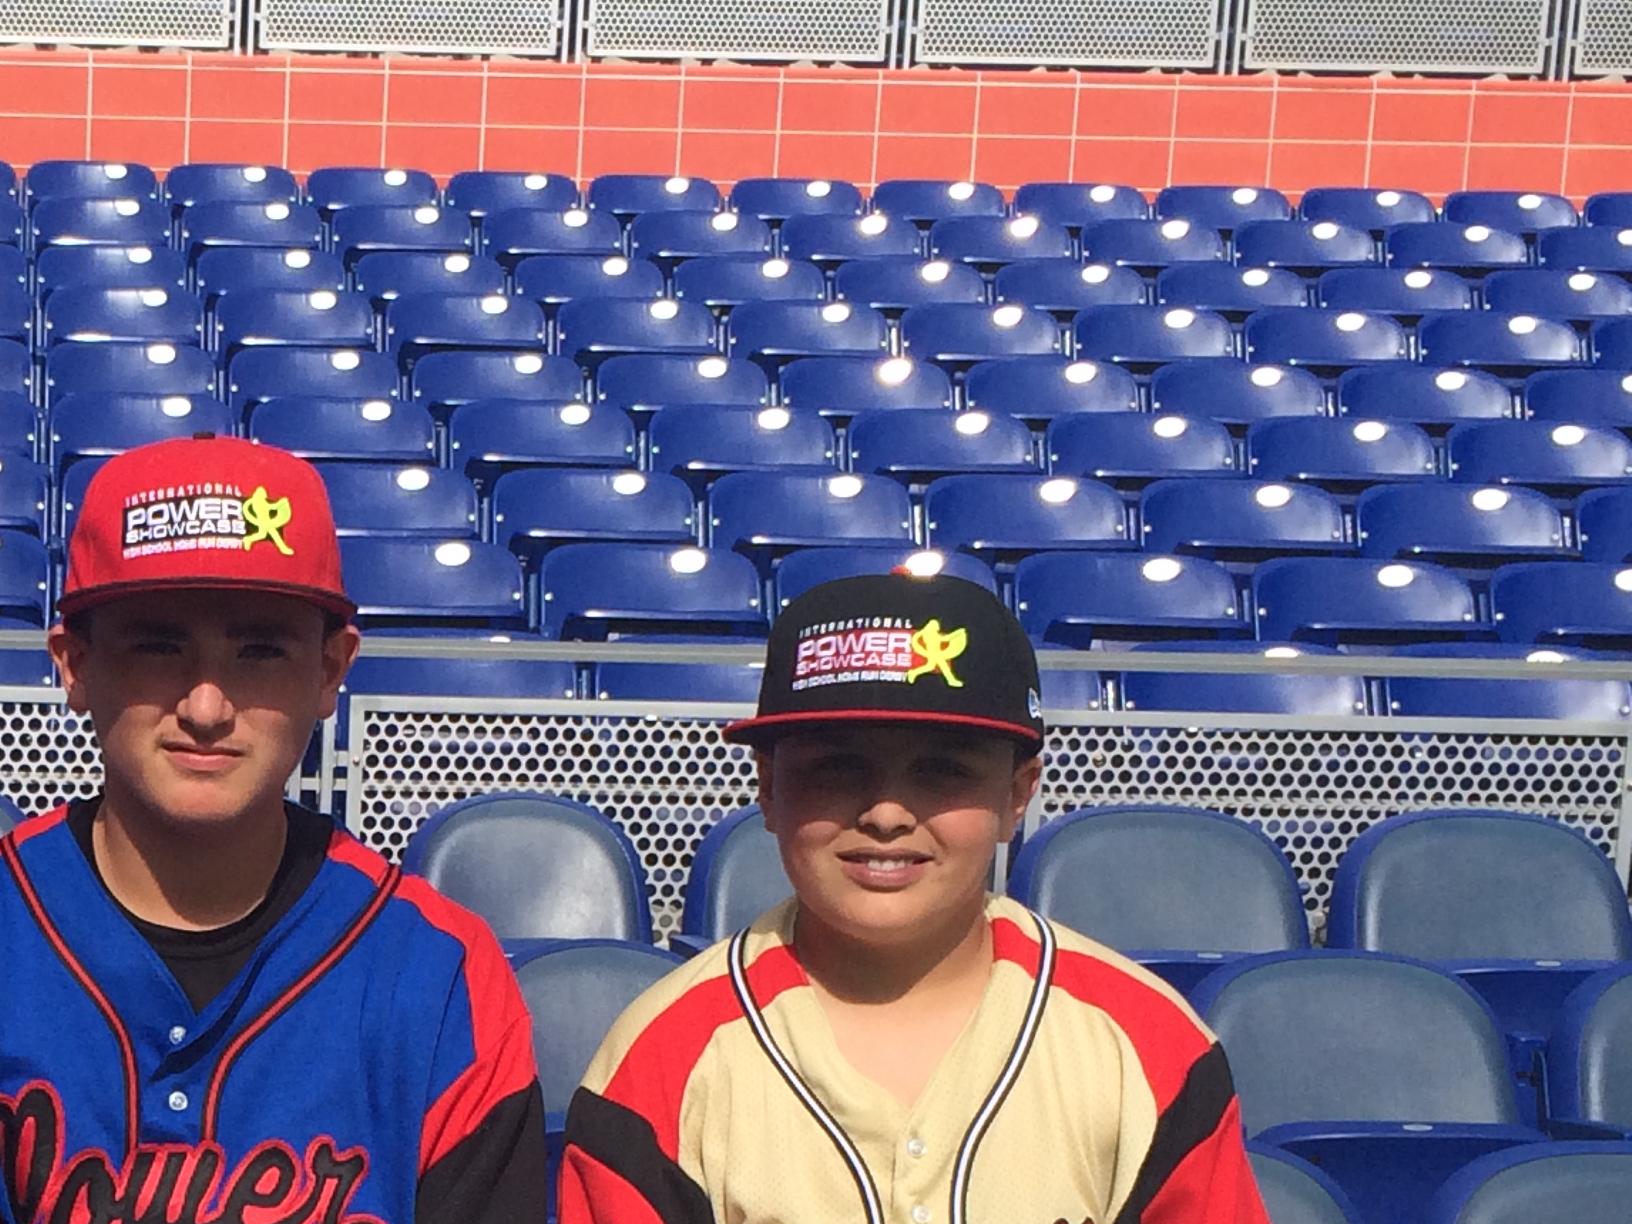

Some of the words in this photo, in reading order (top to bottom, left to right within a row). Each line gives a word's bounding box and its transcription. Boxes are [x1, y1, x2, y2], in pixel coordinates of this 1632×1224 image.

[125, 482, 243, 507] INTERNATIONAL
[127, 497, 243, 530] POWER
[125, 520, 247, 544] SHOWCASE
[798, 616, 914, 638] INTERNATIONAL
[797, 632, 913, 663] POWER
[795, 653, 913, 676] SHOWCASE
